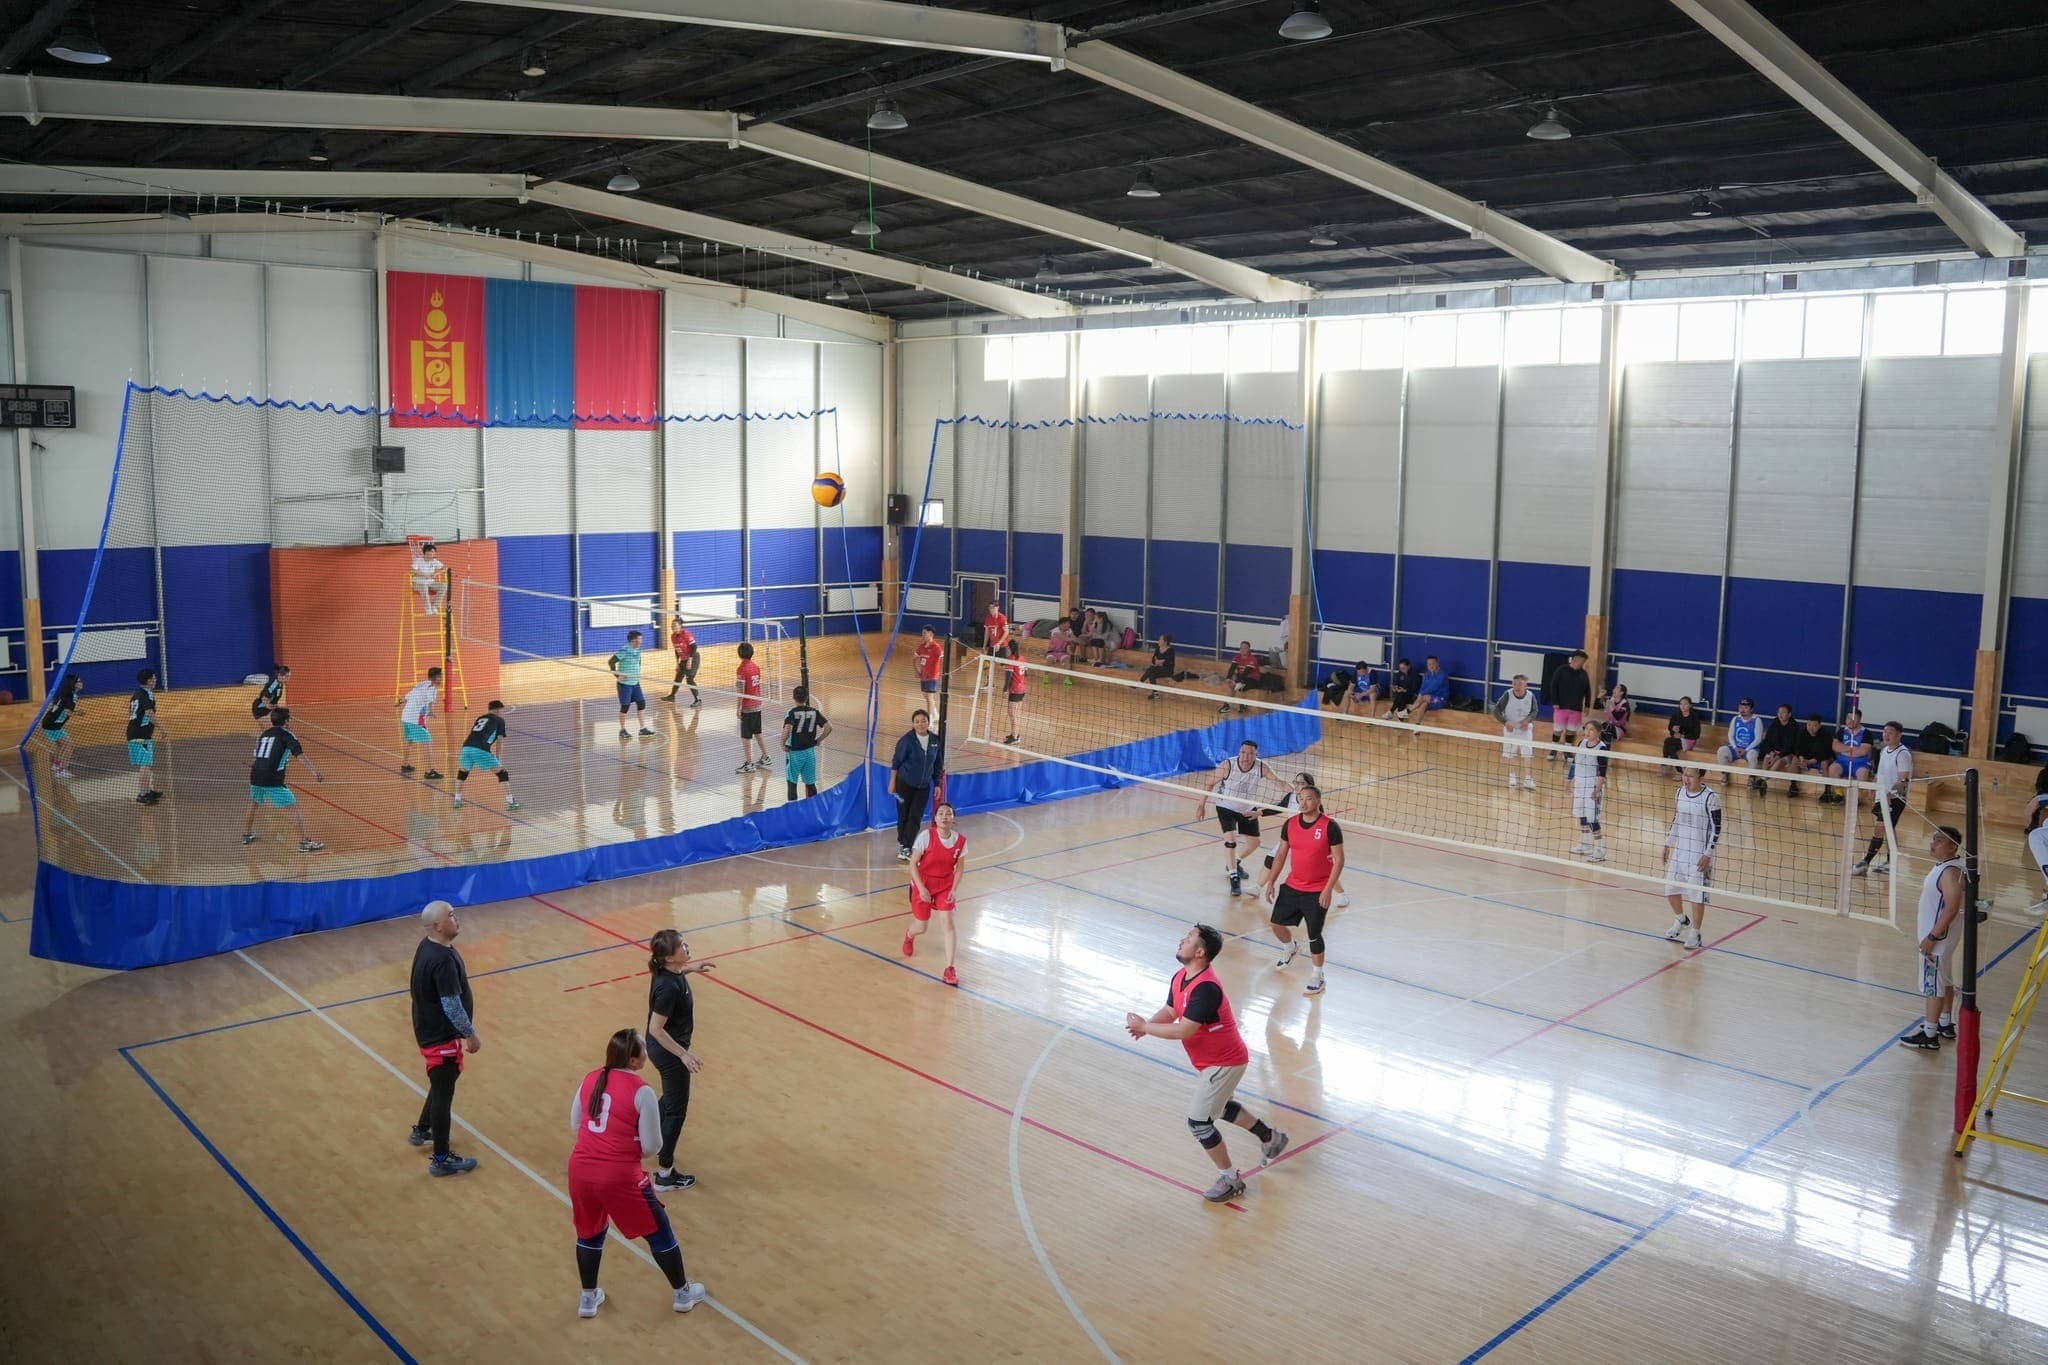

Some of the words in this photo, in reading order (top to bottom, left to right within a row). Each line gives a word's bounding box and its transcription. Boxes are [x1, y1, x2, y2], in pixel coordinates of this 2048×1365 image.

[473, 717, 489, 732] 3
[794, 710, 817, 733] 77
[1314, 828, 1322, 840] 5
